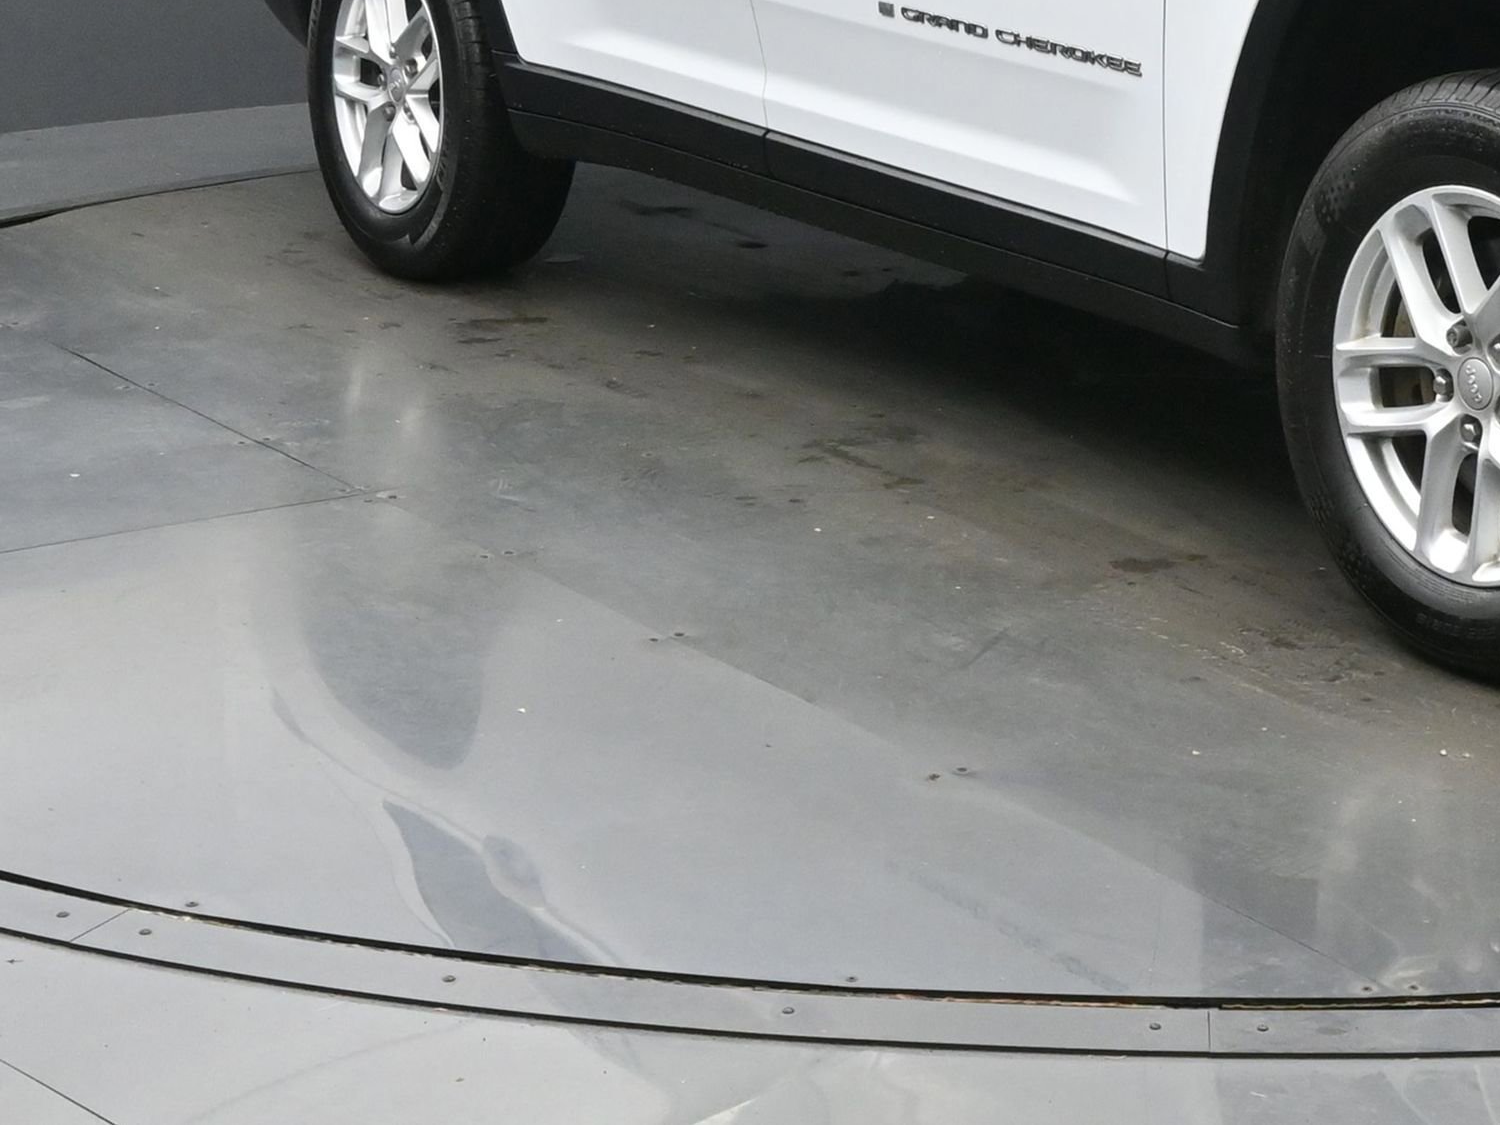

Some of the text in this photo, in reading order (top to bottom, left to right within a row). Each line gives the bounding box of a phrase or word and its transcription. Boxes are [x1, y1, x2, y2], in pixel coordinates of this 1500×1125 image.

[901, 6, 1142, 77] GRAND CHEROKEE
[1465, 364, 1483, 403] Jeep
